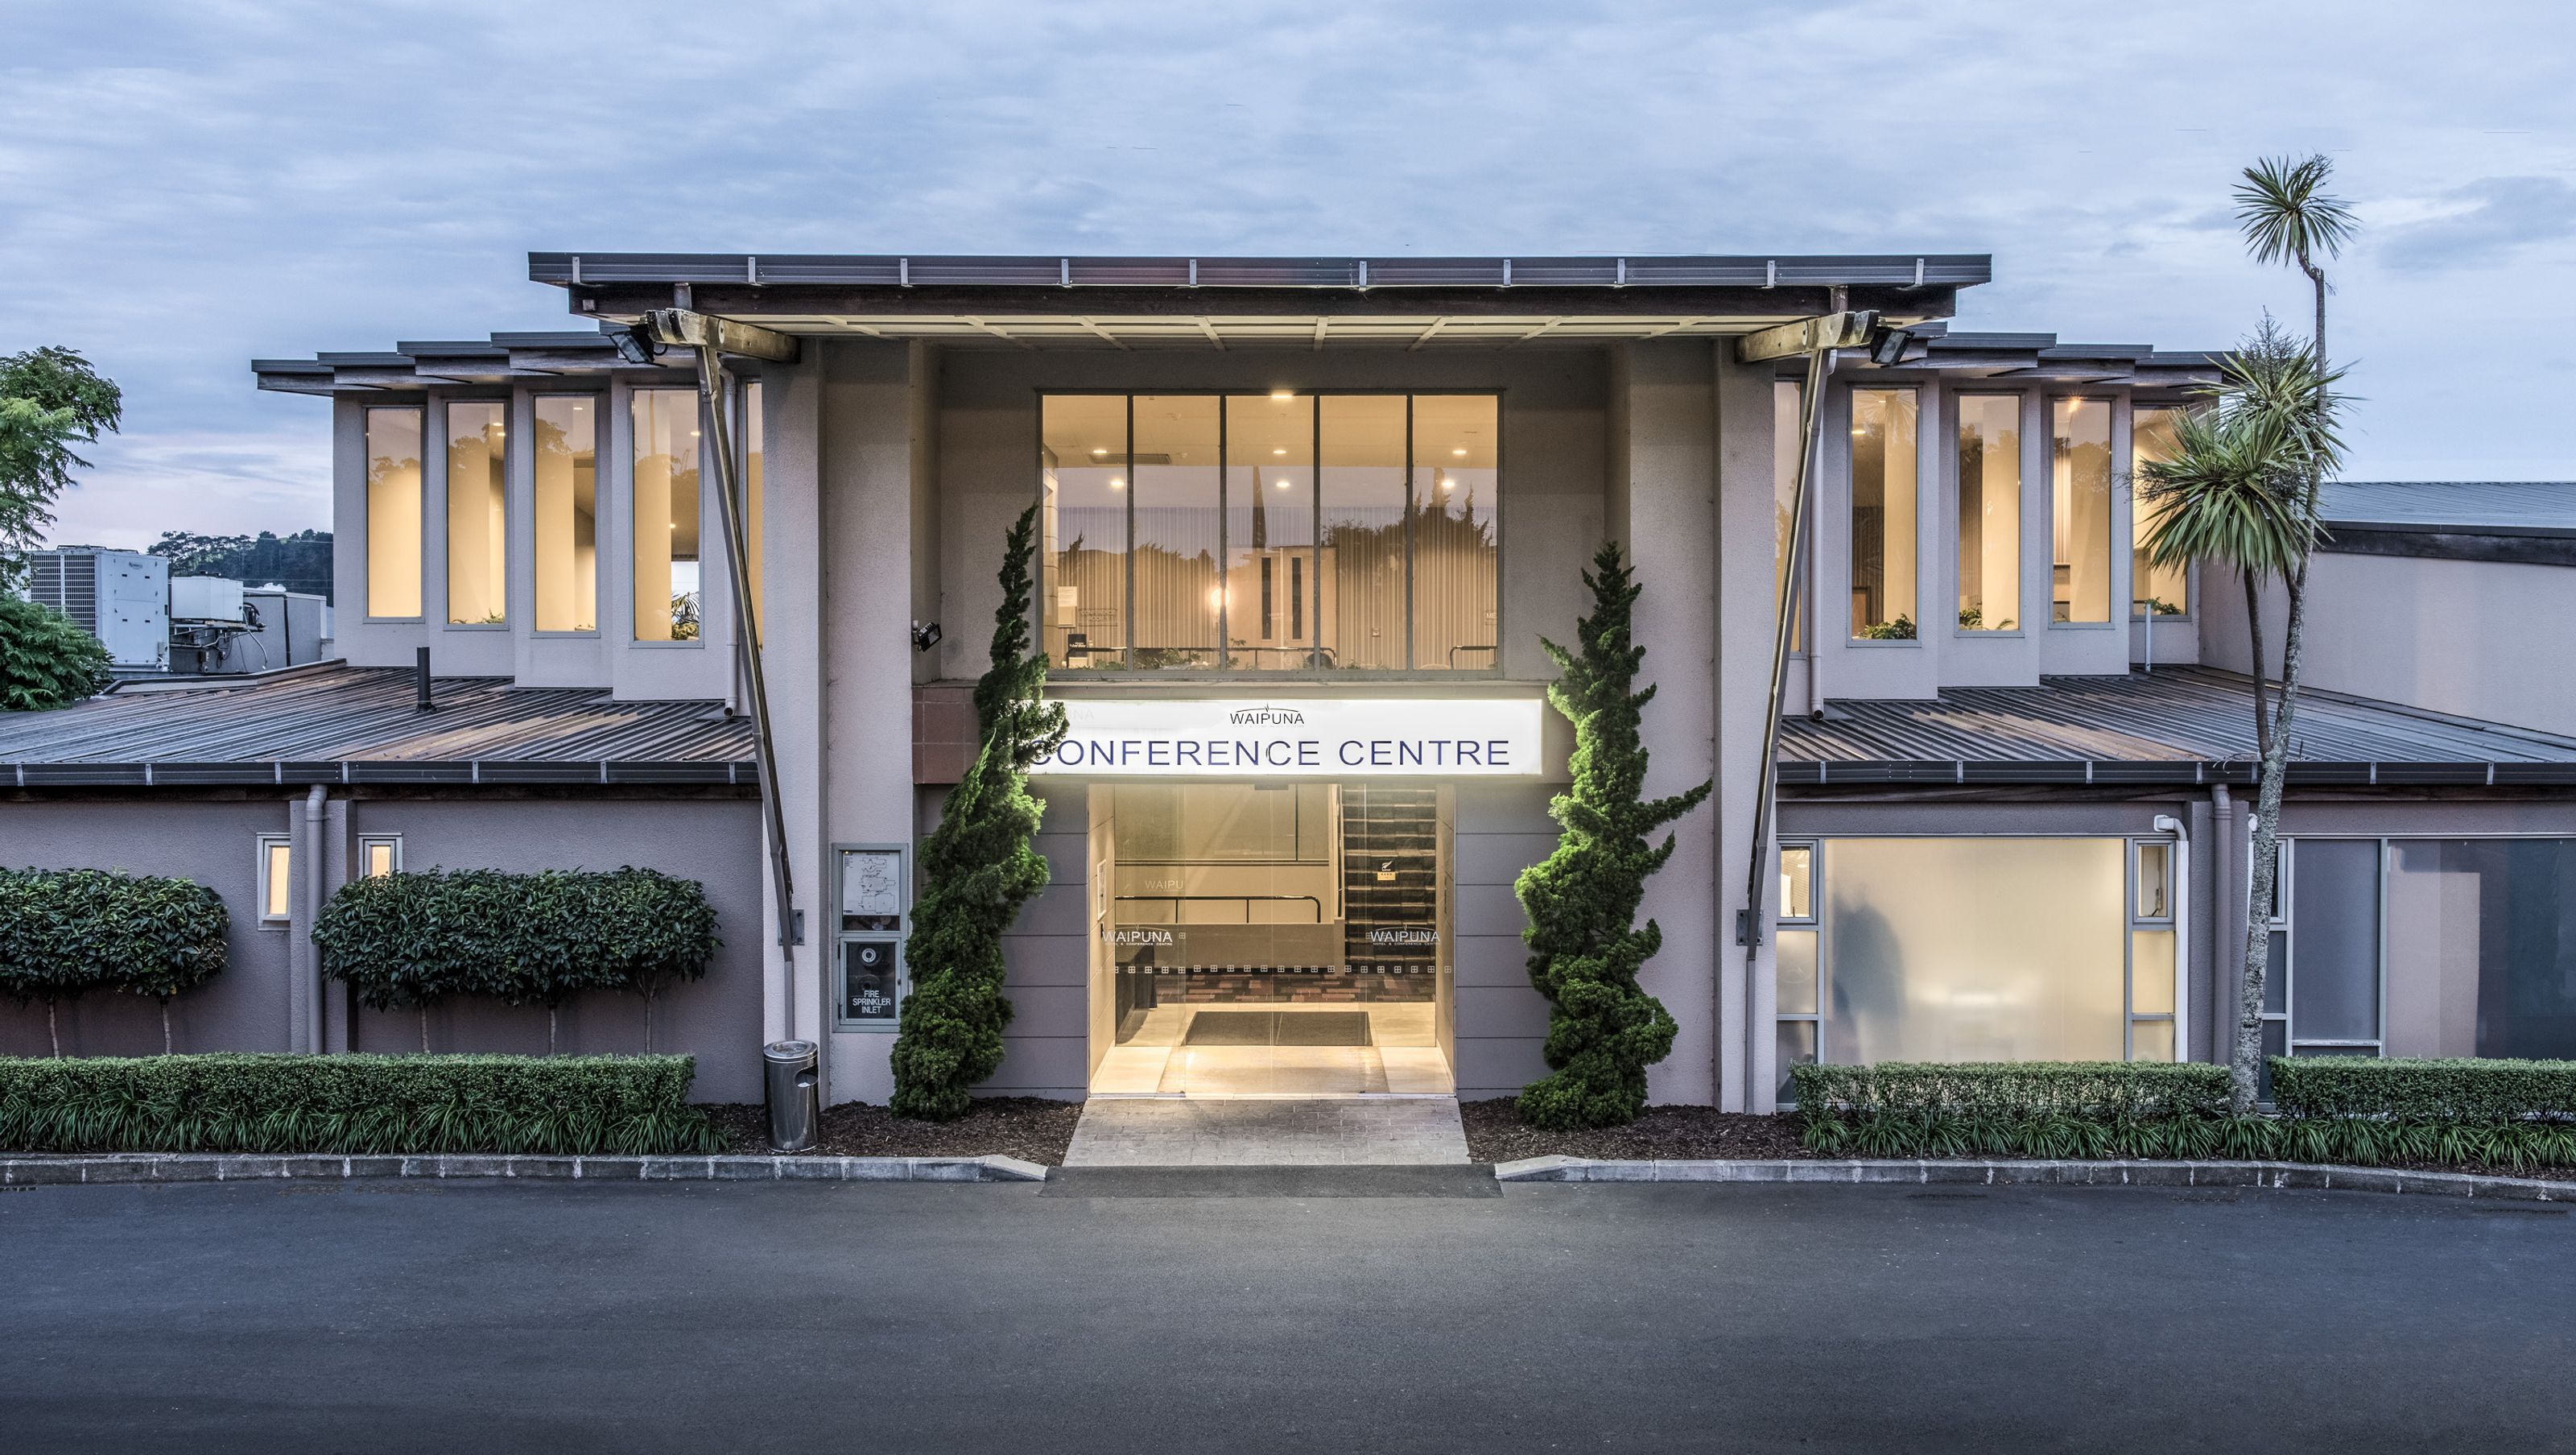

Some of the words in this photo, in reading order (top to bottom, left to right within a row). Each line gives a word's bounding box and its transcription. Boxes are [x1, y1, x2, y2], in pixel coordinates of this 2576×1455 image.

[1229, 713, 1305, 725] WAIPUNA
[1030, 740, 1320, 766] CONFERENCE
[1339, 740, 1510, 766] CENTRE
[1144, 879, 1184, 890] WAIPU
[1102, 931, 1173, 943] WAIPUNA
[1370, 931, 1441, 942] WAIPUNA
[864, 990, 880, 998] FIRE
[852, 998, 891, 1007] SPRINKLER
[861, 1006, 882, 1014] INLET
